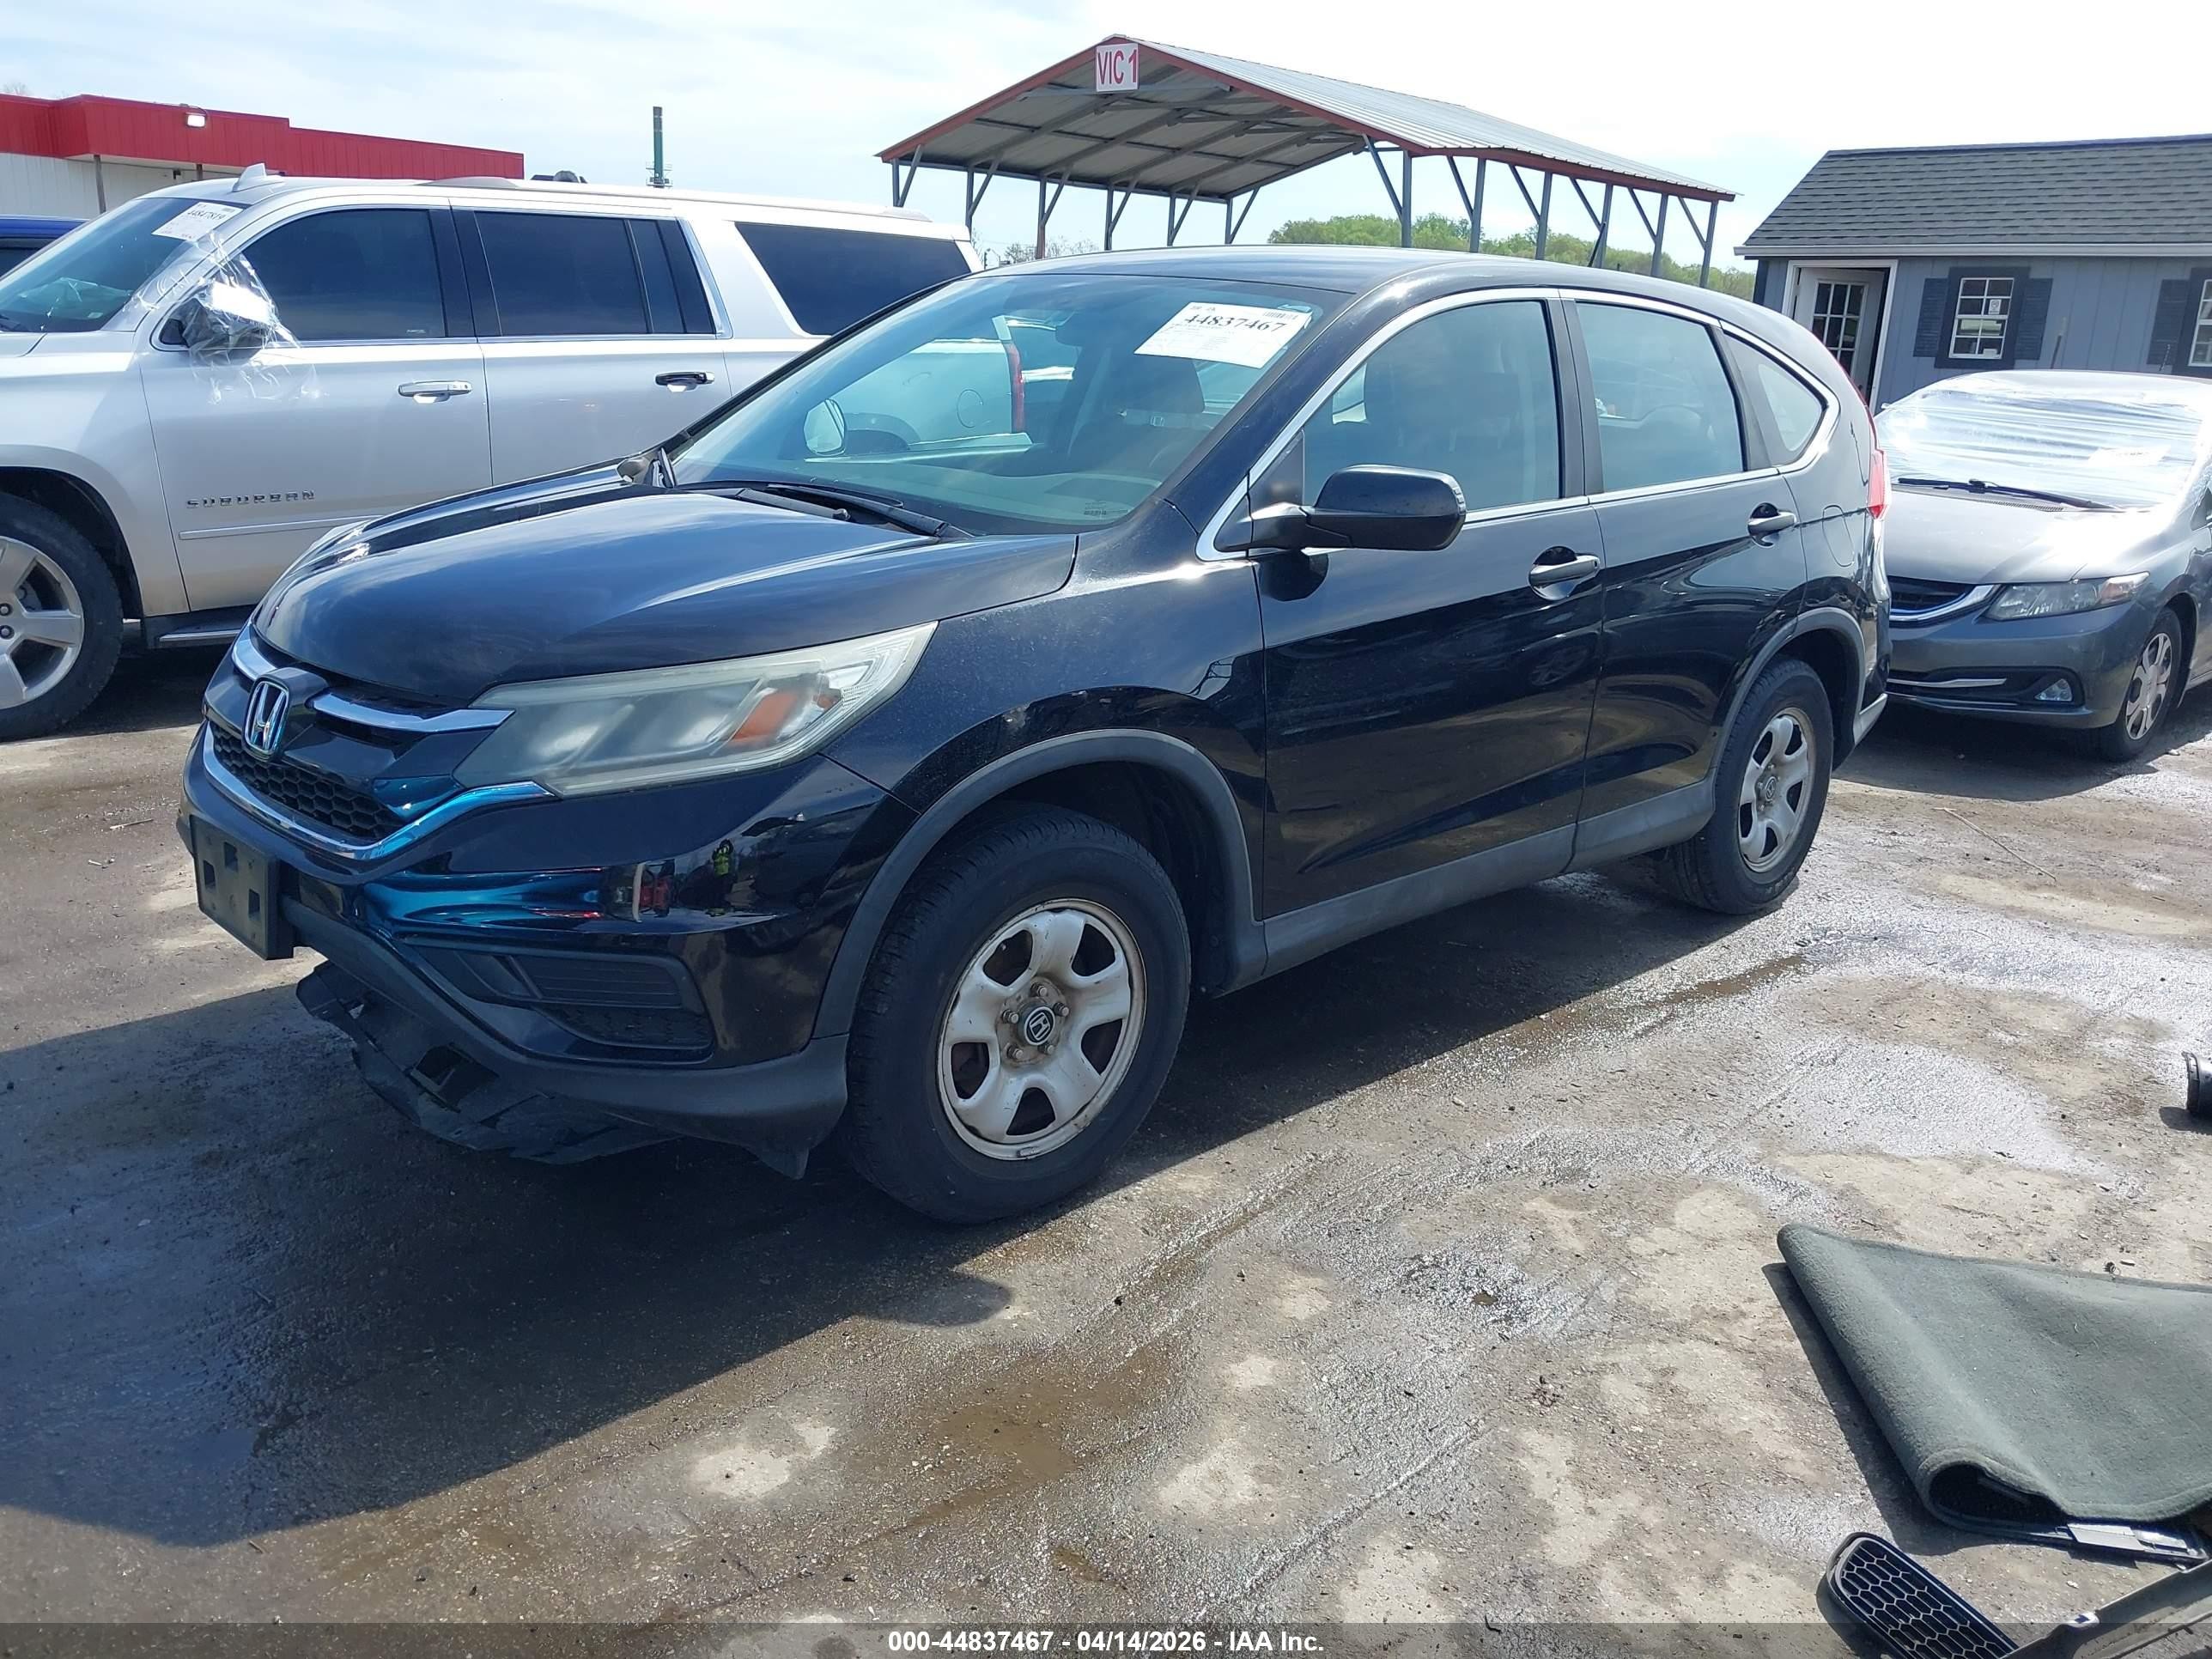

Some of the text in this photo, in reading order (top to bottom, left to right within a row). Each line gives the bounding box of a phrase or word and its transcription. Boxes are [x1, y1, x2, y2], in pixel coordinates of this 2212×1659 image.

[1097, 49, 1137, 84] VIC 1
[1184, 313, 1287, 332] 44837467
[185, 489, 315, 508] SUBURBAN
